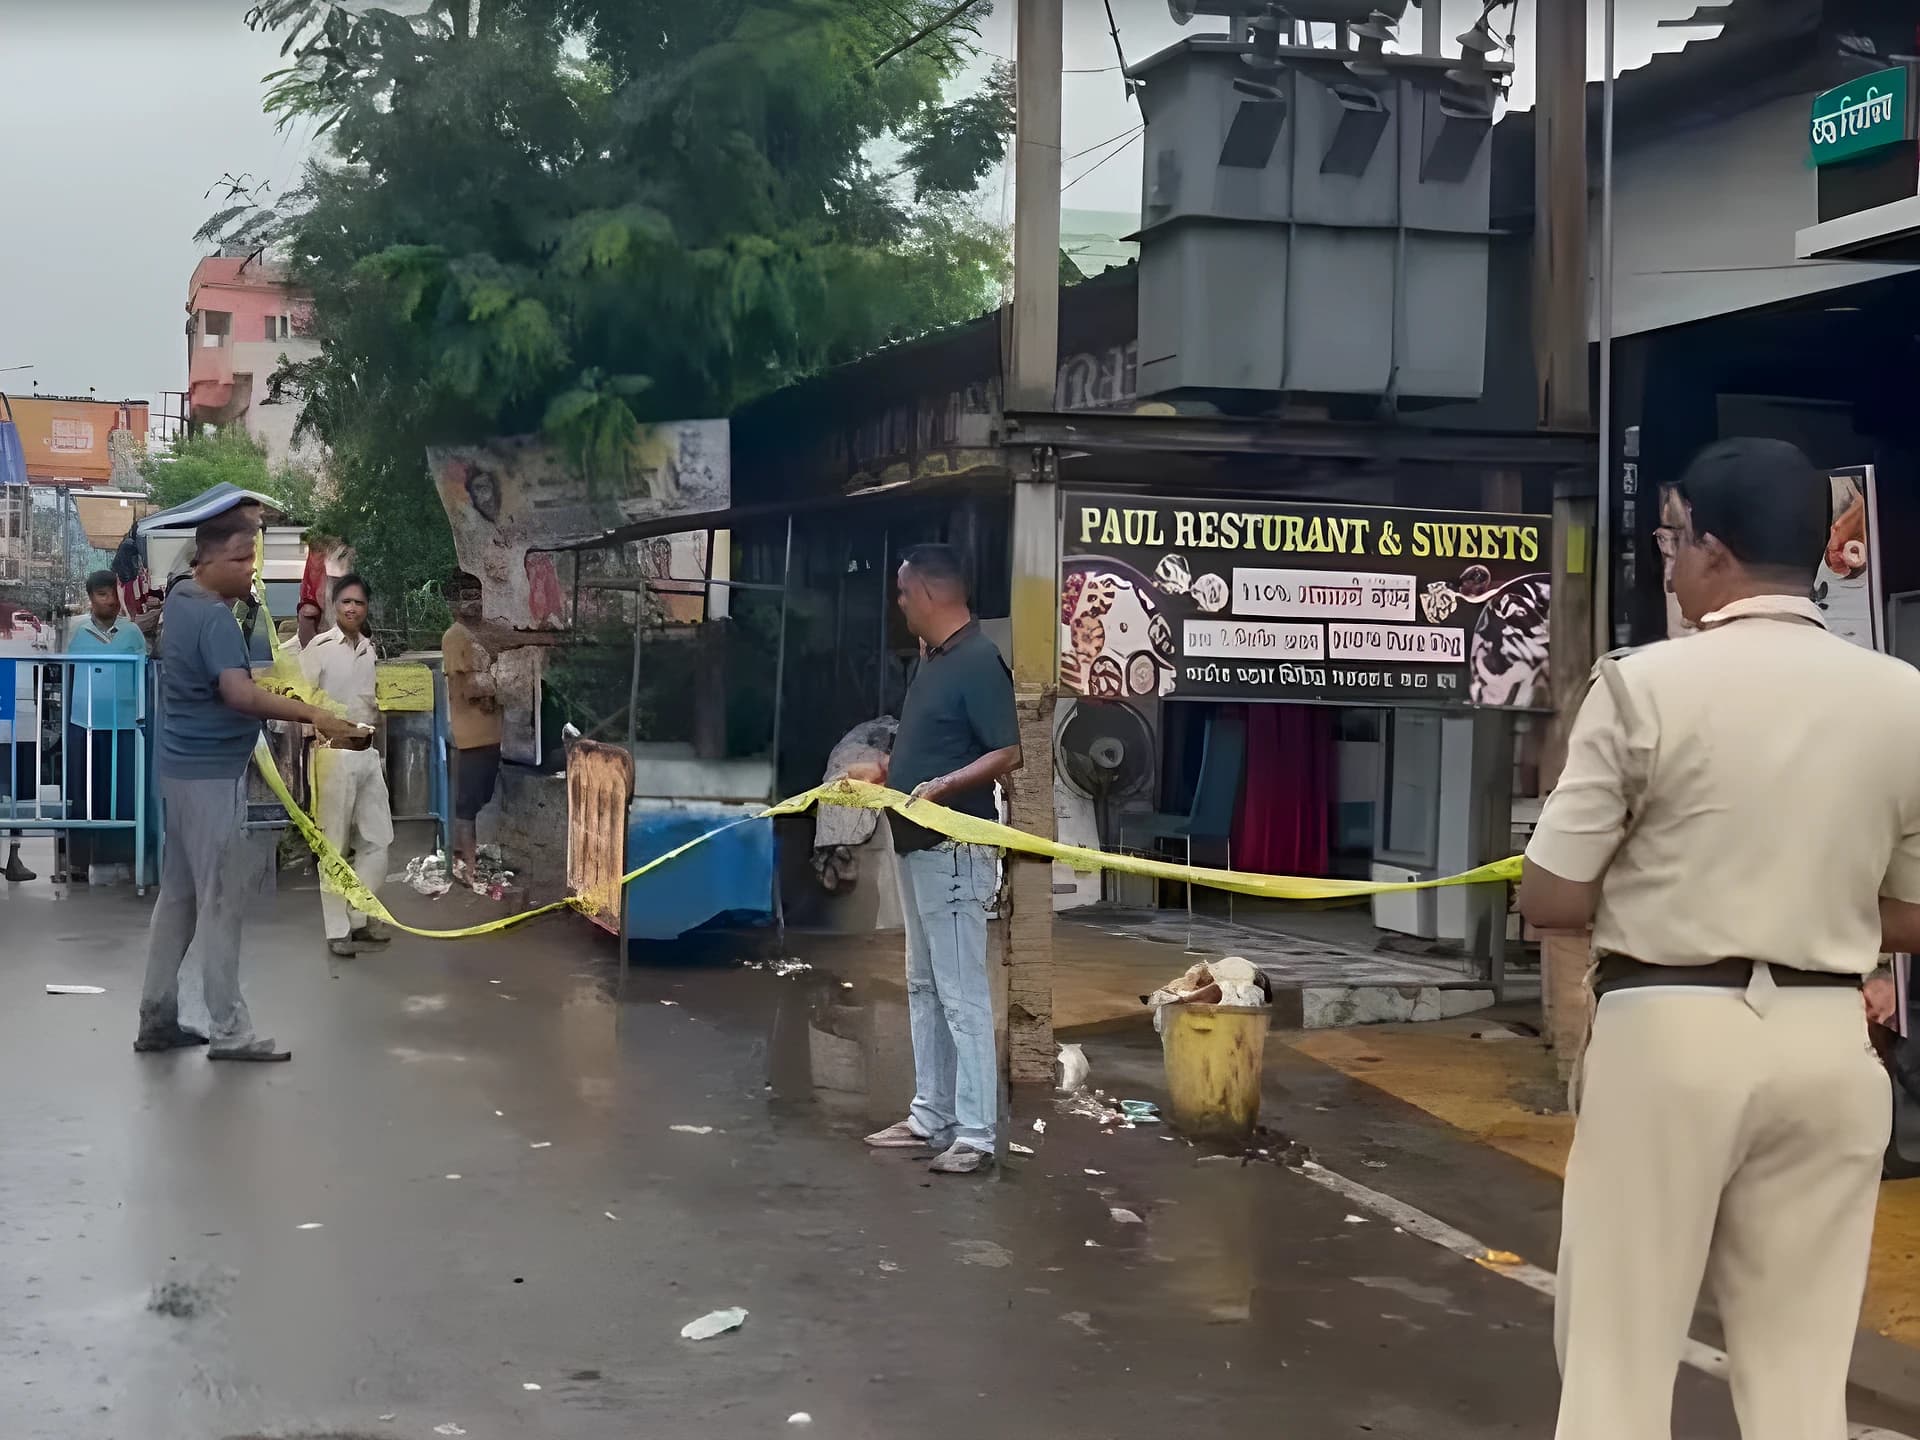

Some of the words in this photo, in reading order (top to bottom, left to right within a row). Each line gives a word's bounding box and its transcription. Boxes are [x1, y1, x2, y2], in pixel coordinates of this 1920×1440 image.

[1080, 507, 1164, 546] PAUL
[1174, 511, 1369, 555] RESTURANT
[1378, 520, 1402, 556] &
[1411, 522, 1539, 562] SWEETS
